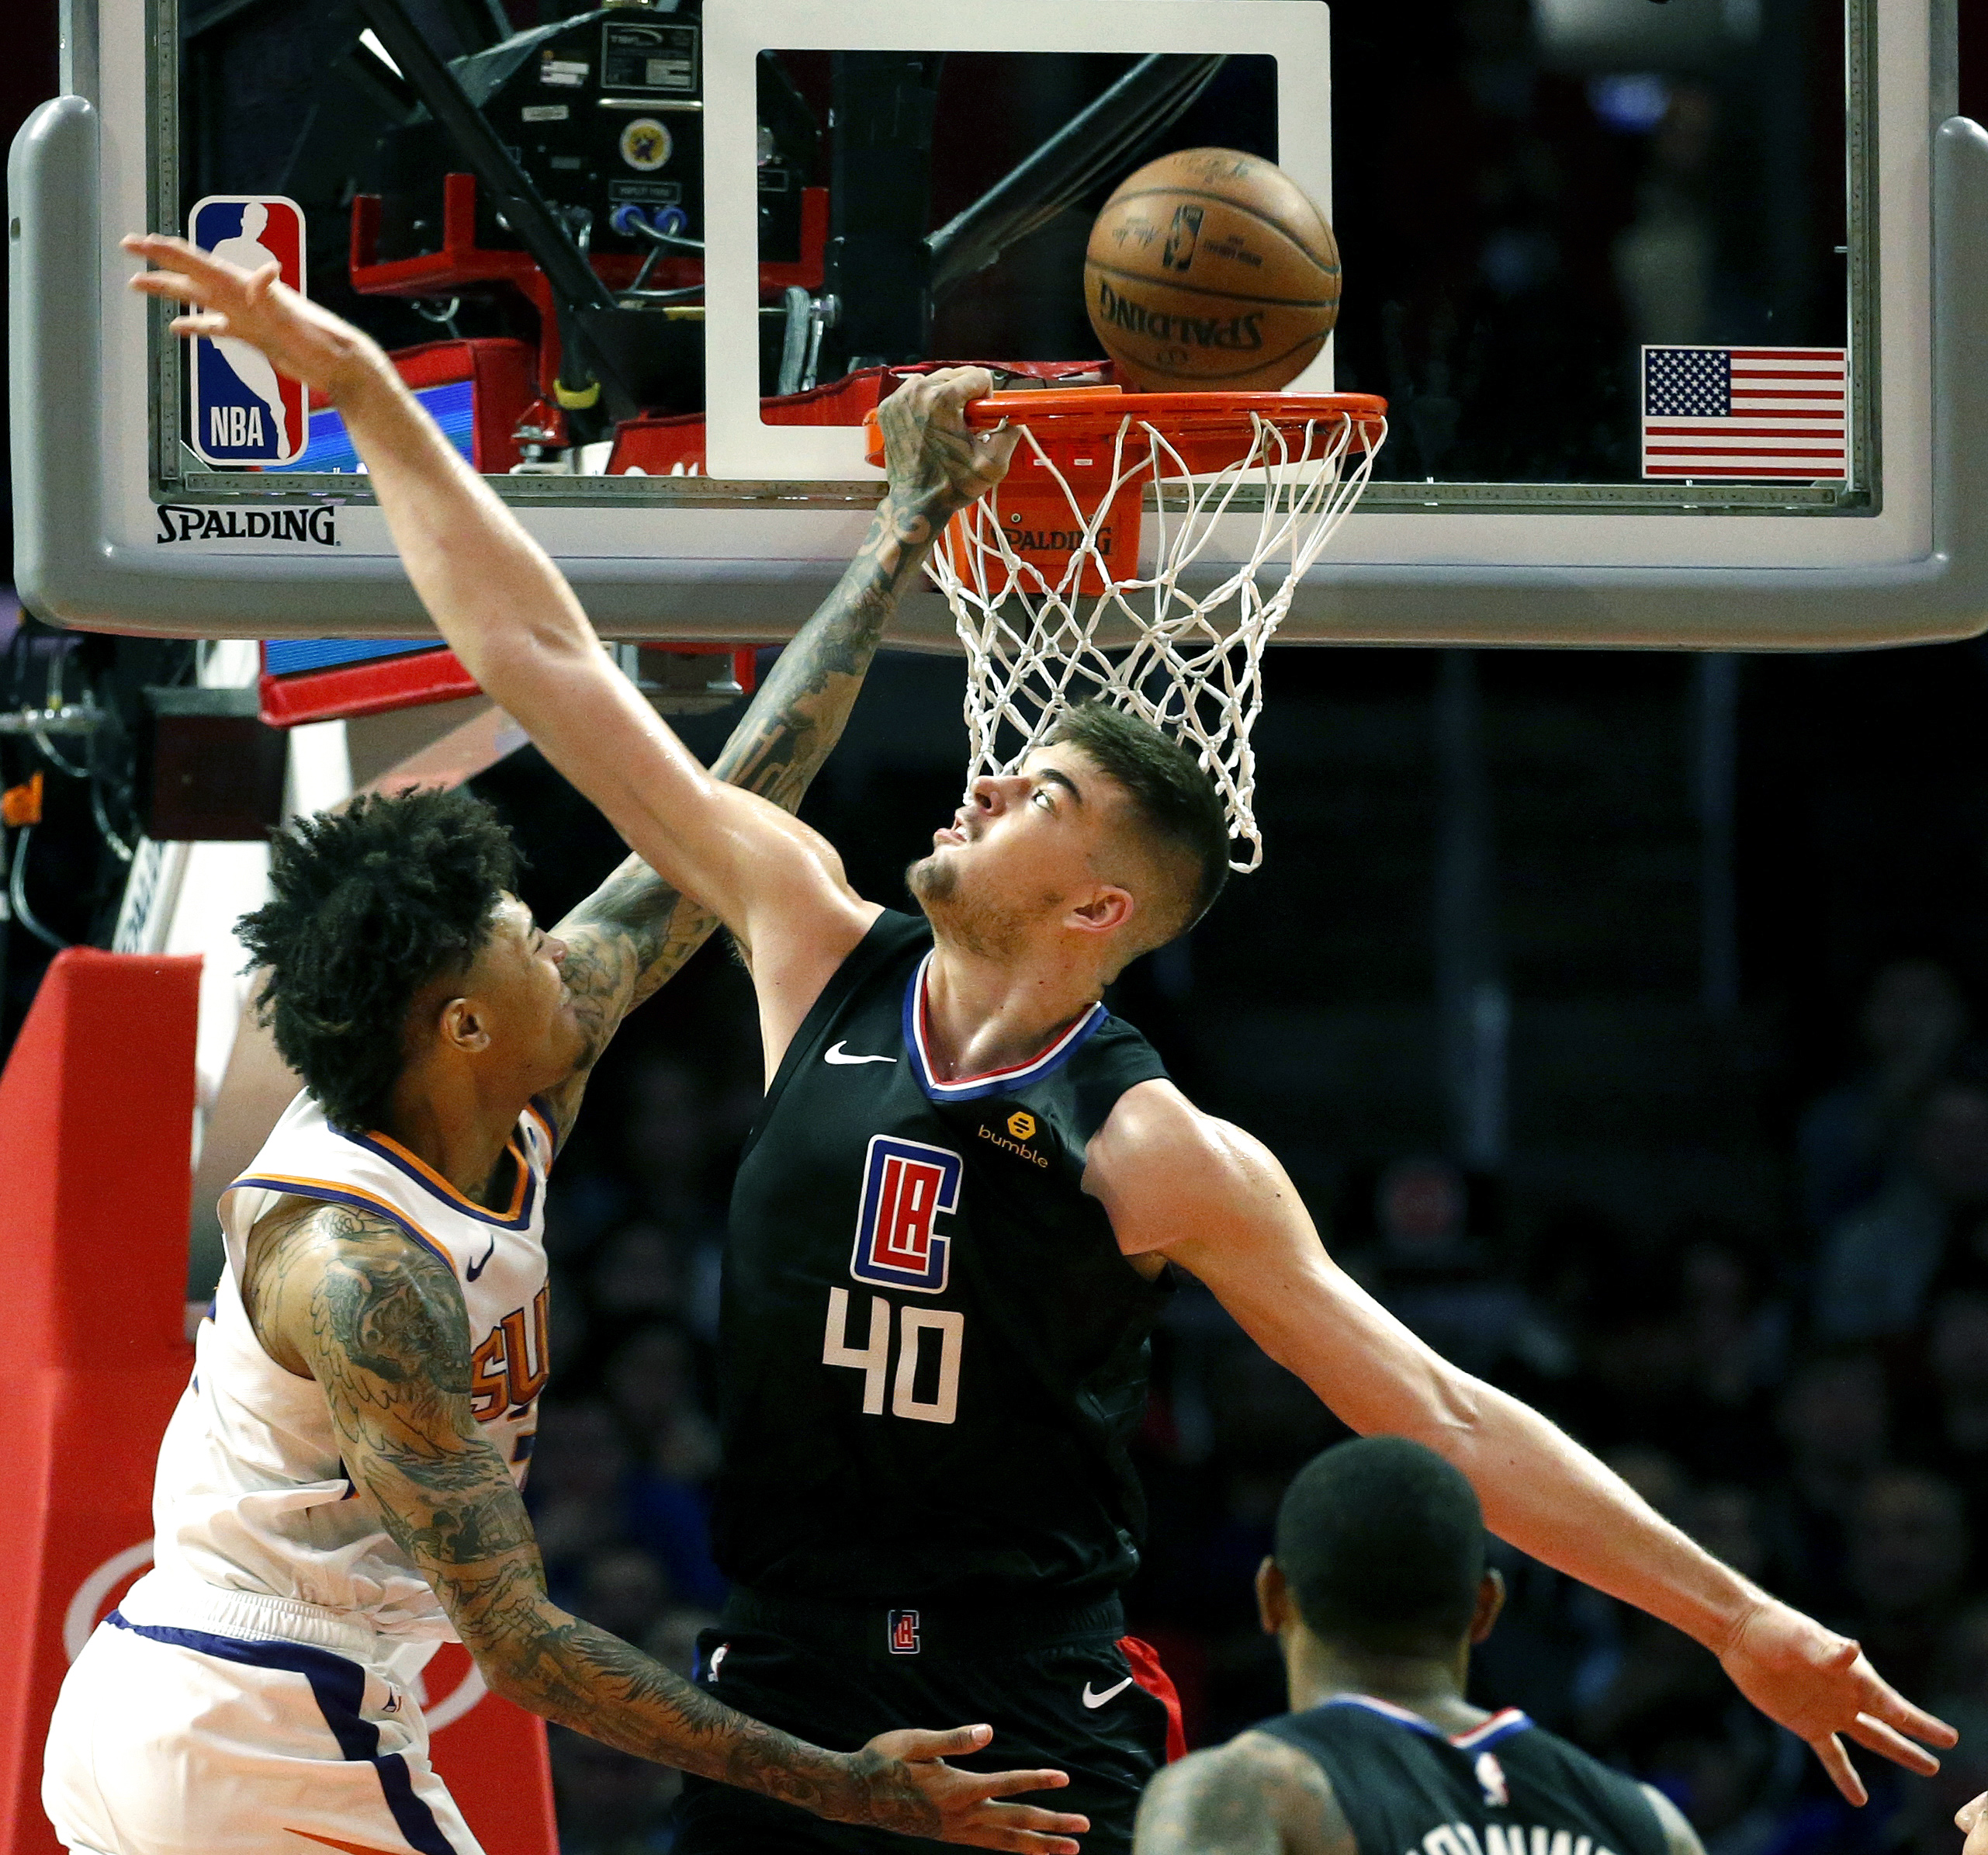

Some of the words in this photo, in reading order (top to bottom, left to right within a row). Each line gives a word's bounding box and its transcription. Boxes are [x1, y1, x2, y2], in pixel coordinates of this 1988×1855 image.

[1100, 280, 1266, 350] SPALDING
[210, 406, 265, 448] NBA
[157, 504, 334, 546] SPALDING
[991, 527, 1112, 555] PALDIG
[977, 1125, 1048, 1169] bumble
[822, 1287, 965, 1425] 40
